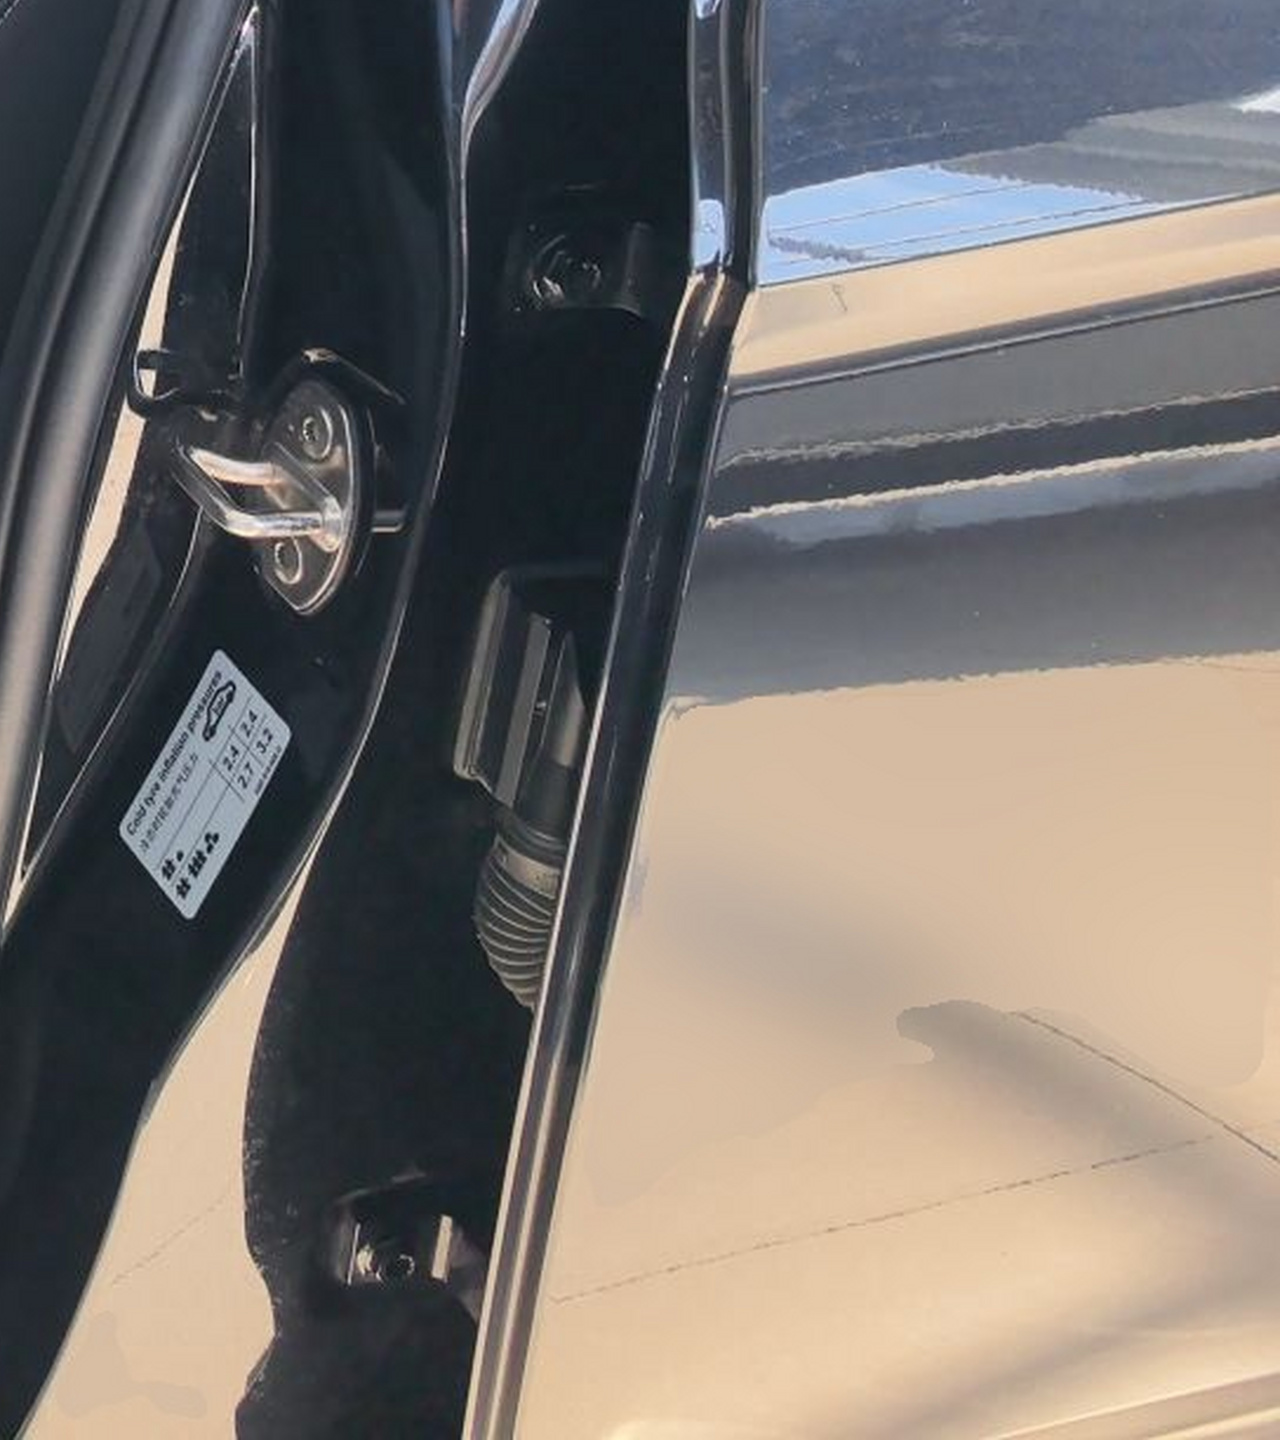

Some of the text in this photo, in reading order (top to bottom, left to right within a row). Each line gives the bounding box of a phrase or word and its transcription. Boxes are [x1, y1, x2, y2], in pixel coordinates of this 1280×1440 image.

[126, 670, 222, 836] Cold tyre inflation pressures
[223, 709, 258, 772] 2.4 2.4
[237, 761, 254, 790] 2.7
[256, 727, 274, 754] 3.2
